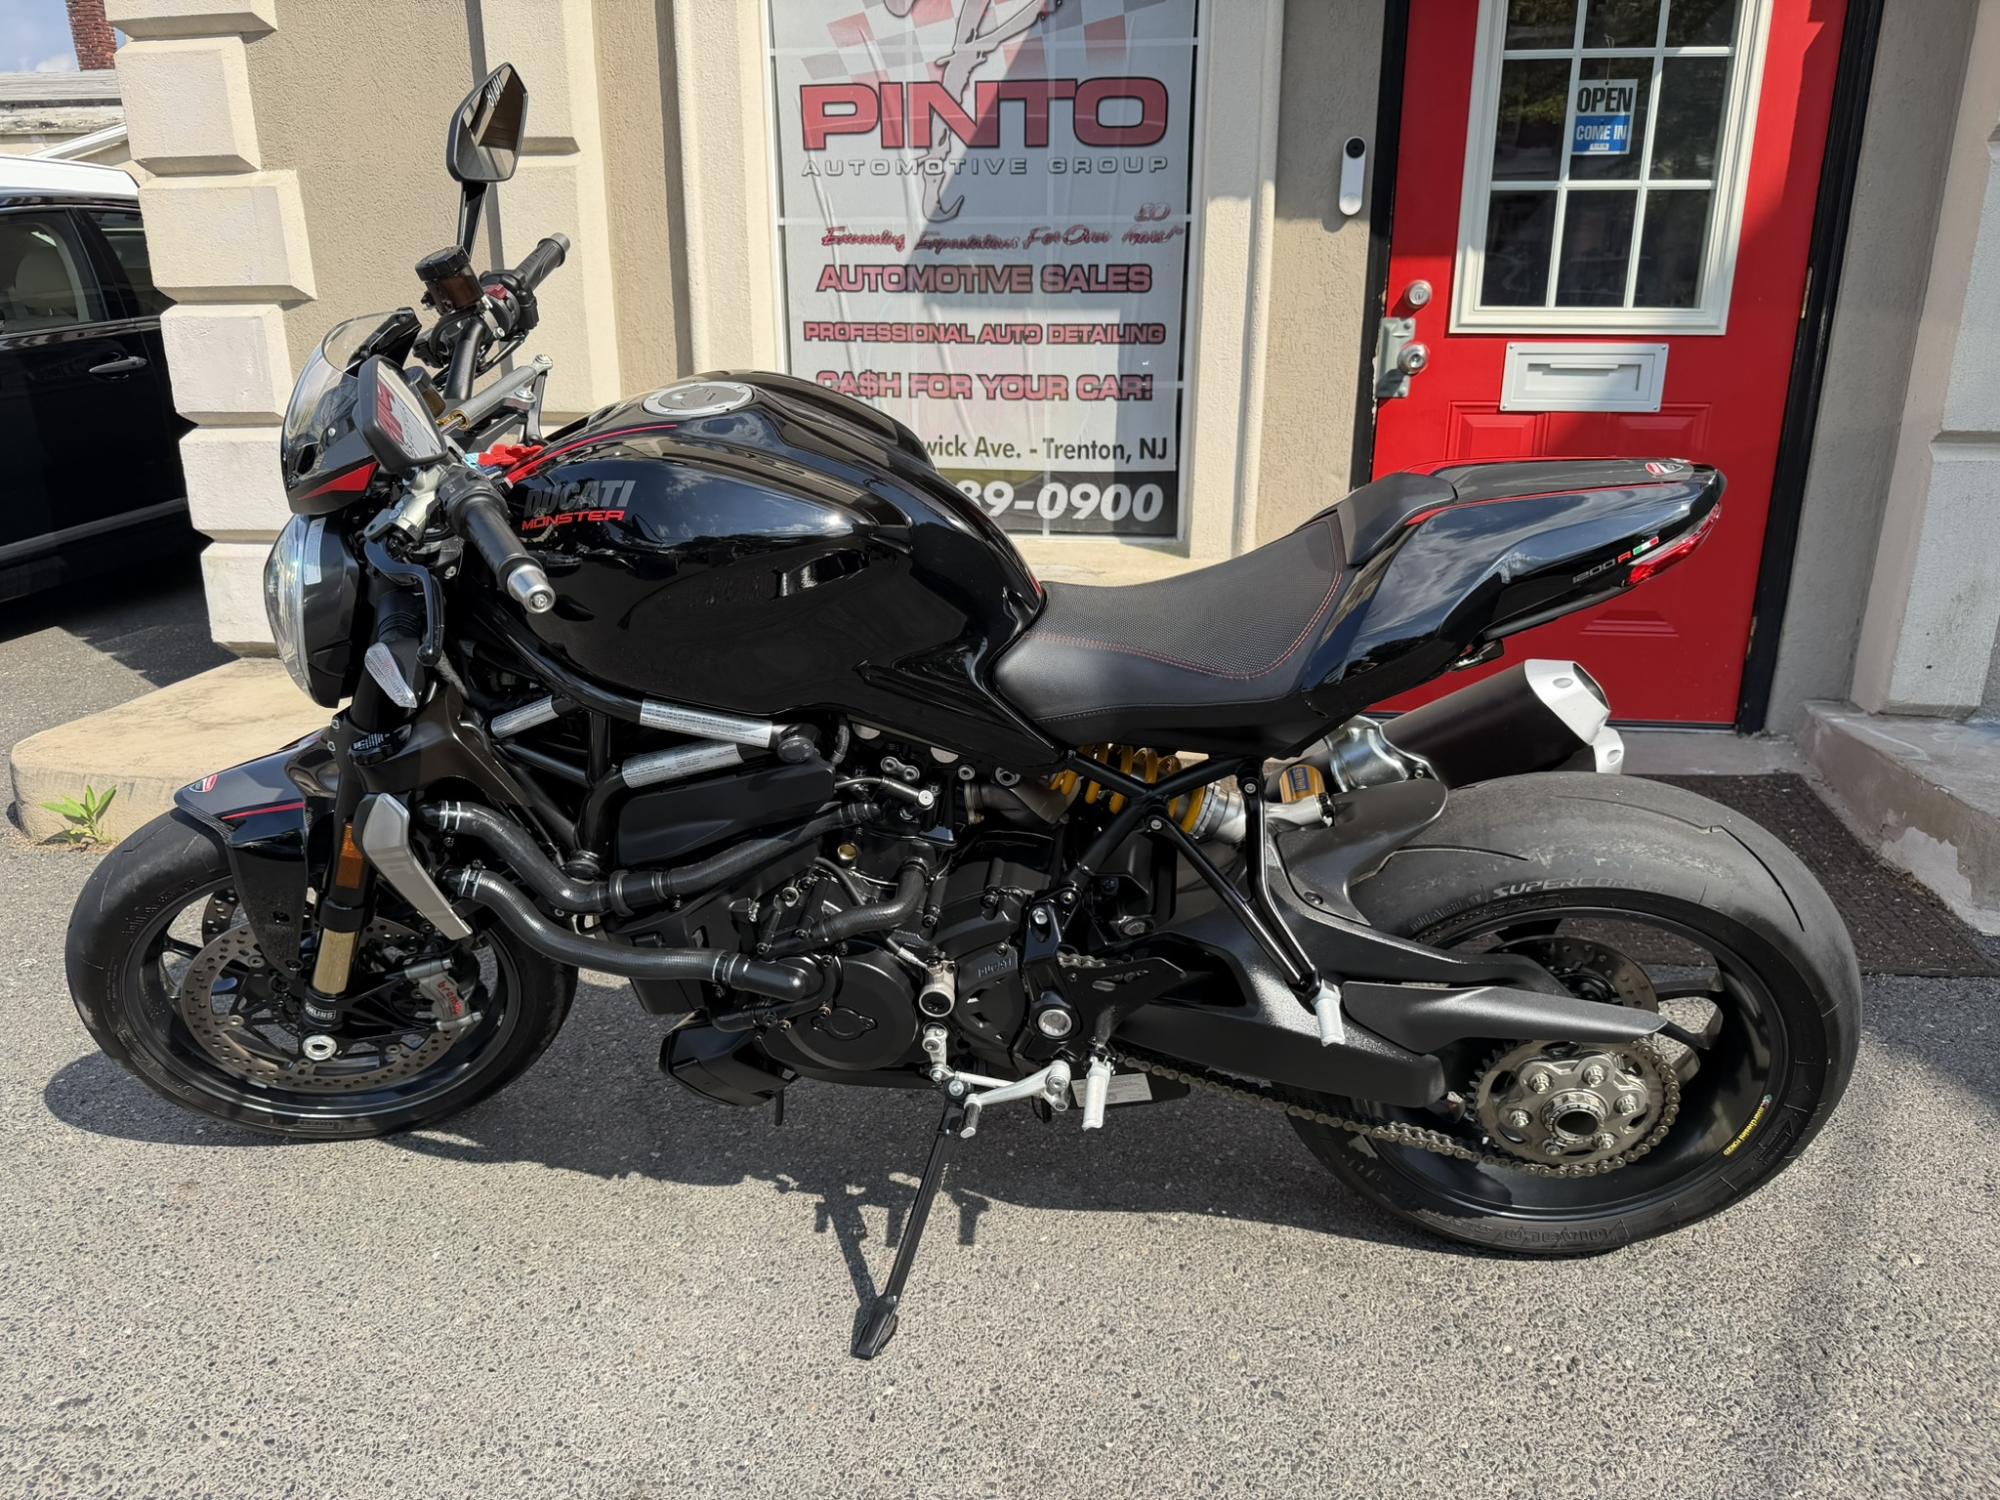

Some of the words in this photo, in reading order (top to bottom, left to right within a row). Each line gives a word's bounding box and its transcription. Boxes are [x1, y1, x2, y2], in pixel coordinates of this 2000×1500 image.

[1577, 87, 1633, 112] OPEN
[800, 77, 1169, 150] PINTO
[1576, 125, 1611, 140] COME
[1613, 125, 1628, 140] IN
[801, 158, 1027, 176] AUTOMOTIVE
[1048, 156, 1169, 175] GROUP
[816, 264, 1033, 294] AUTOMOTIVE
[1041, 264, 1152, 293] SALES
[803, 322, 975, 344] PROFESSIONAL
[978, 323, 1043, 345] AUTO
[1046, 323, 1166, 345] DETAILING
[816, 370, 901, 399] CA$H
[909, 372, 972, 400] FOR
[977, 373, 1068, 401] YOUR
[1076, 373, 1154, 401] CAR!
[973, 436, 1021, 459] Ave.
[1043, 438, 1132, 463] Trenton,
[1139, 437, 1167, 460] NJ
[524, 480, 637, 518] DUCATI
[522, 510, 625, 532] MONSTER
